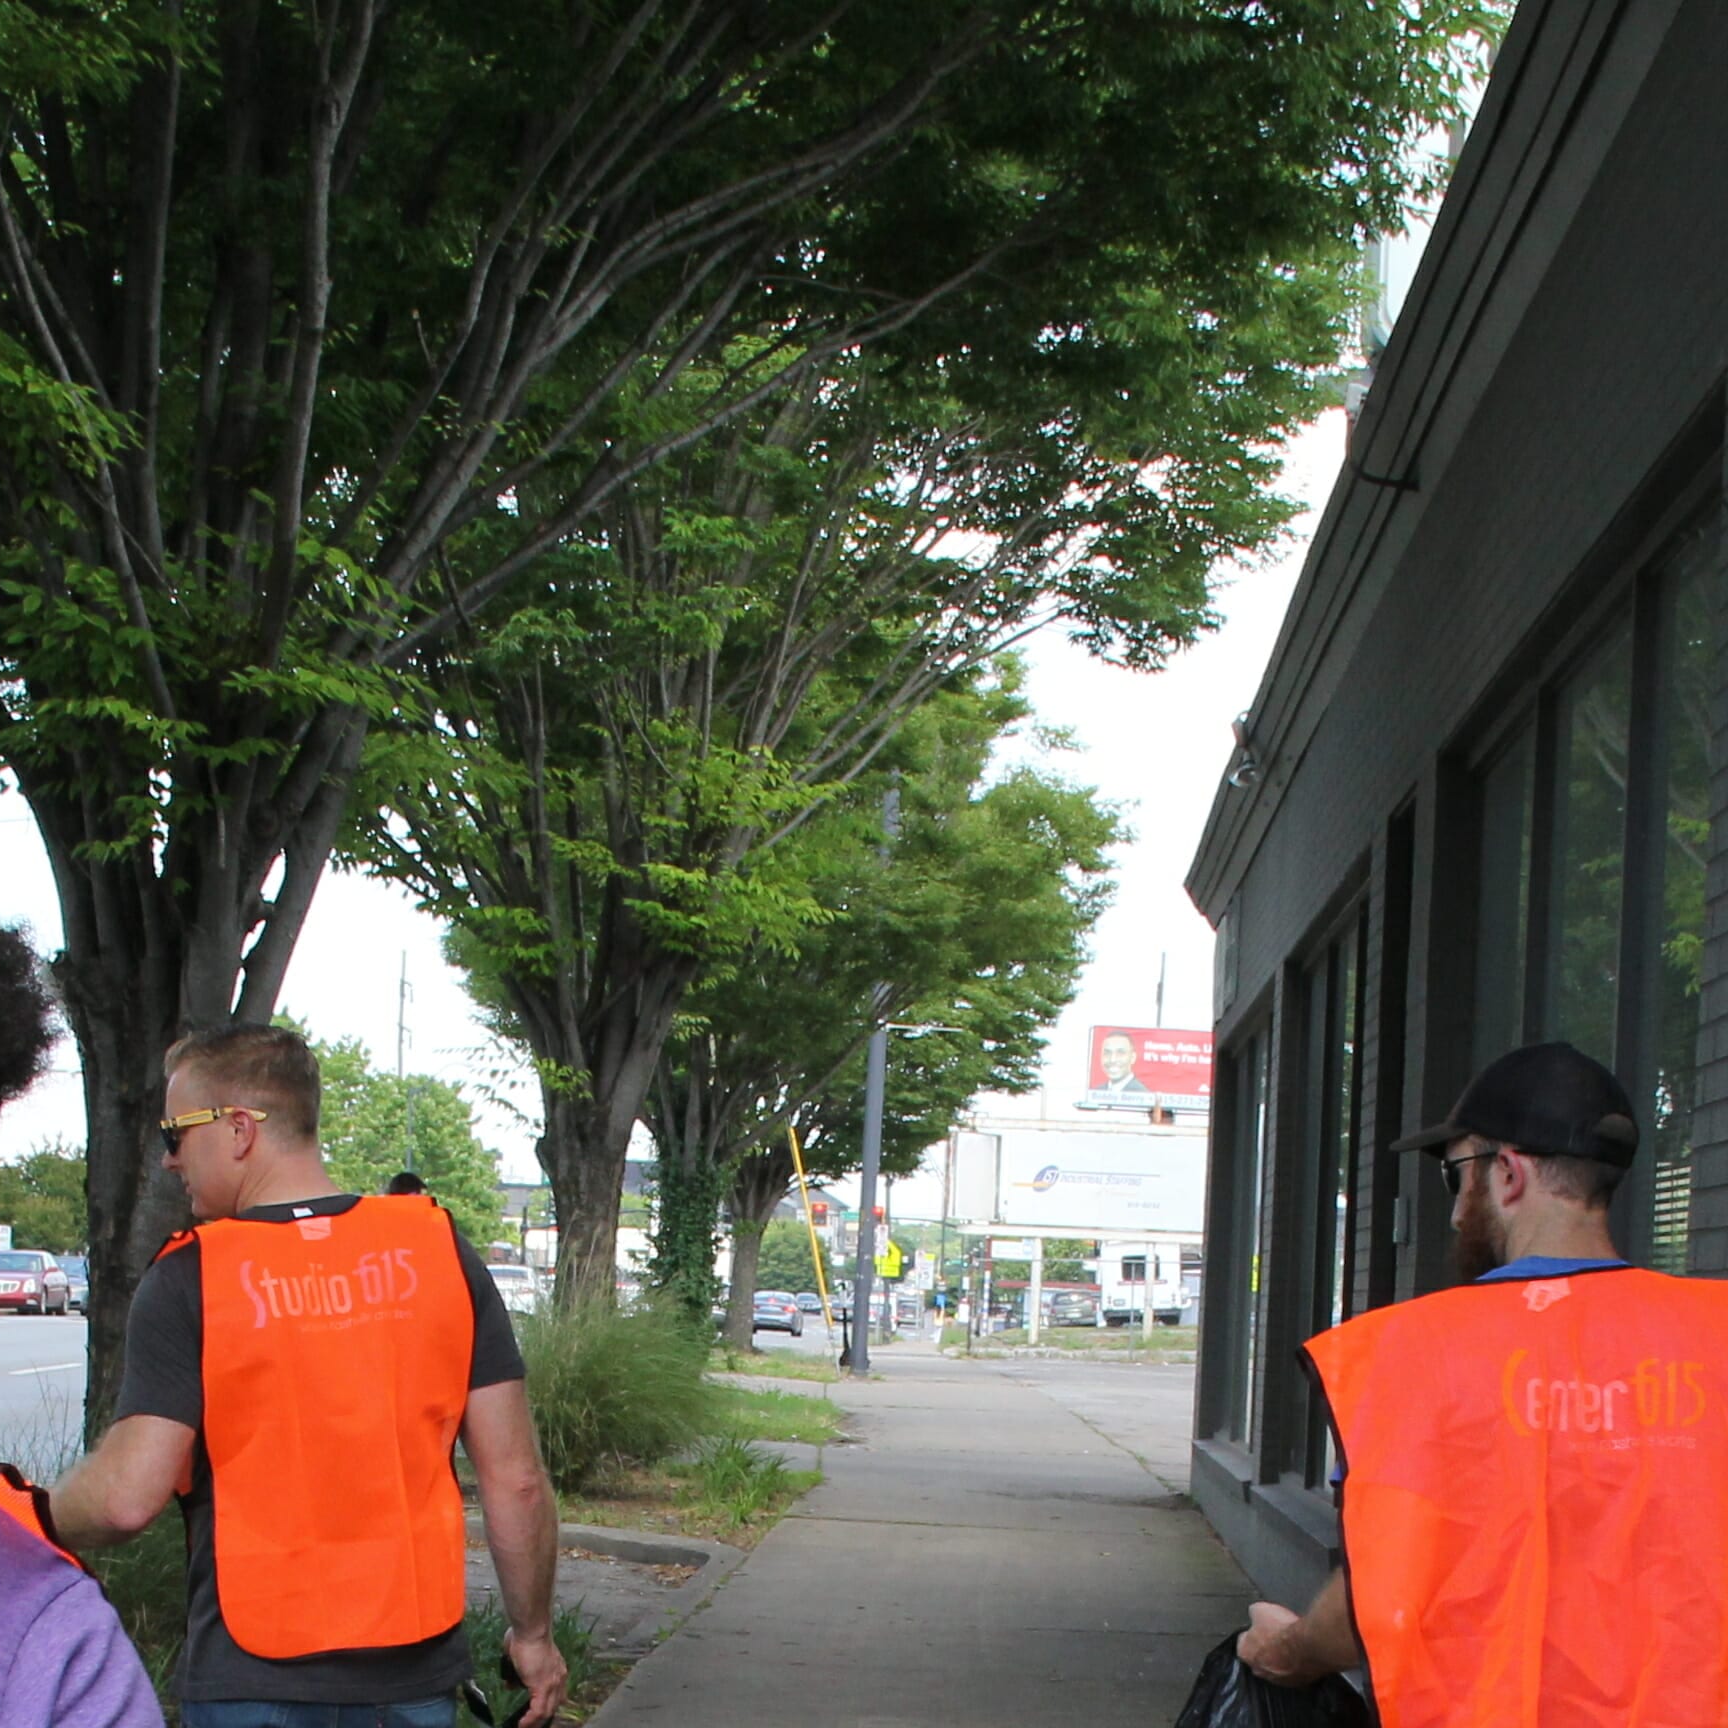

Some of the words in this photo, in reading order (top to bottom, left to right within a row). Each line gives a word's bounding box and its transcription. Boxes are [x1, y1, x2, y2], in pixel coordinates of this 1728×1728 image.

[1160, 1053, 1180, 1065] why
[240, 1259, 353, 1328] Studio
[353, 1249, 418, 1304] 615
[1630, 1359, 1707, 1428] 615
